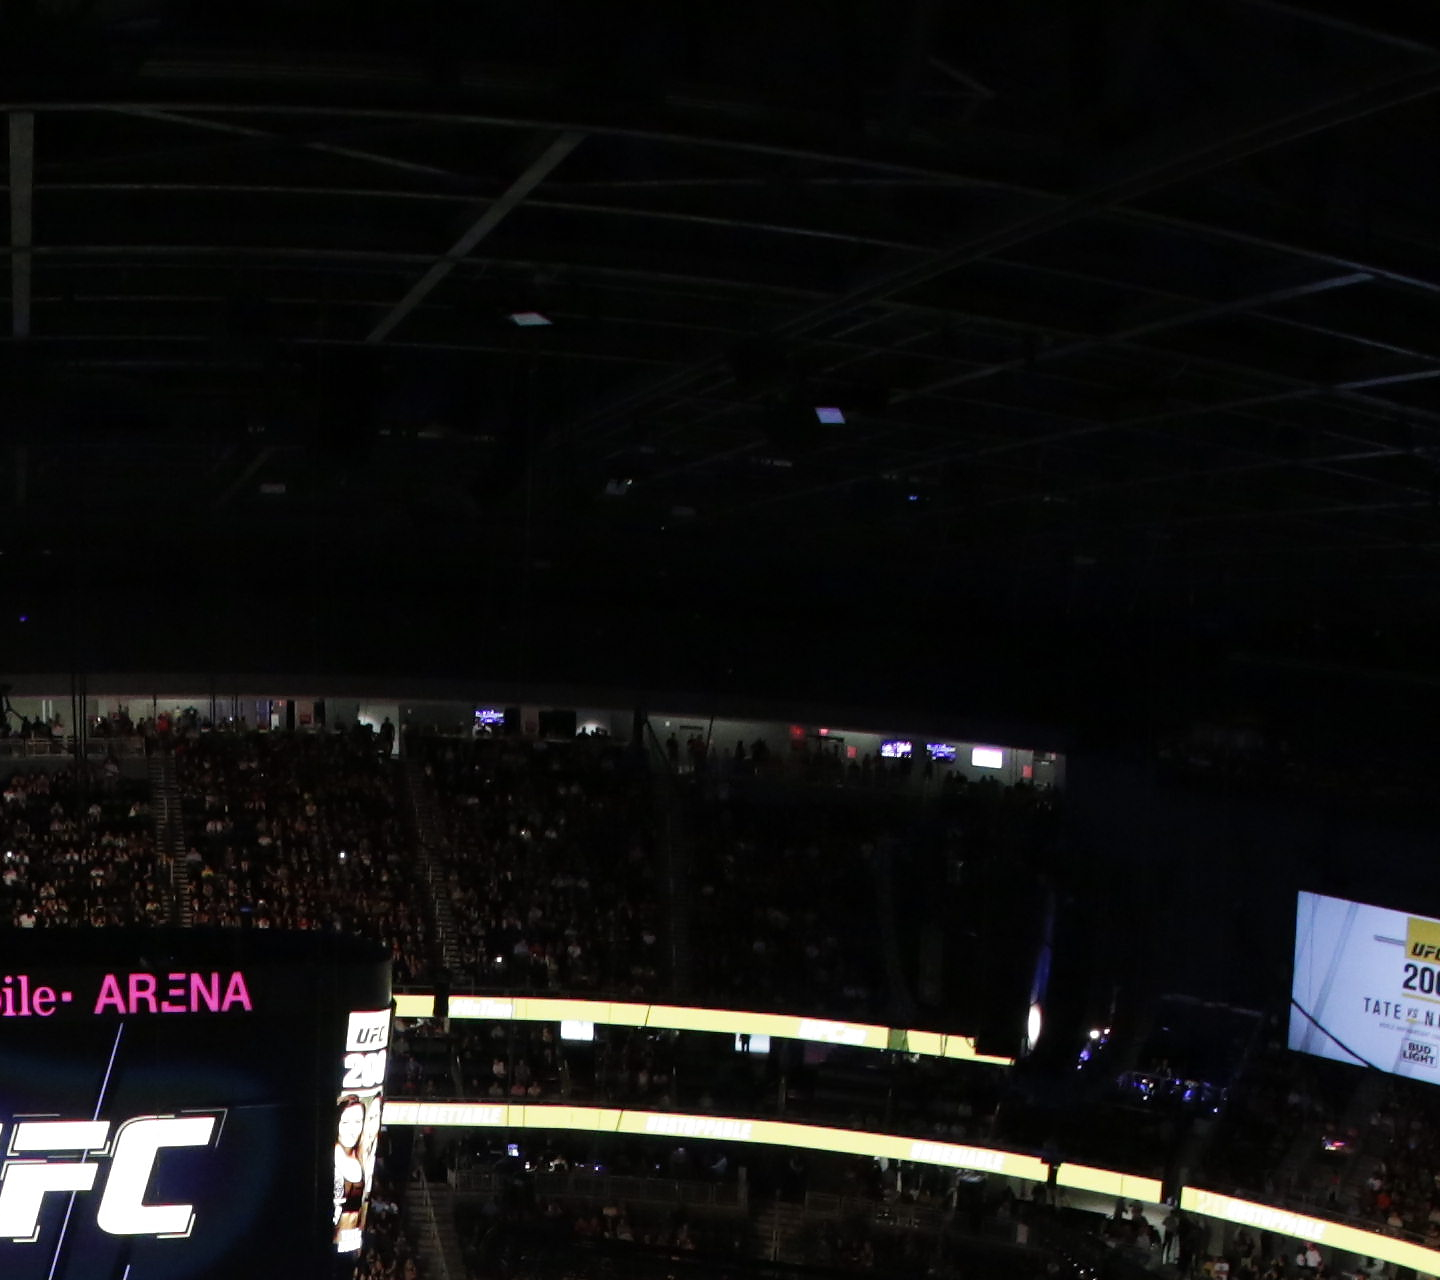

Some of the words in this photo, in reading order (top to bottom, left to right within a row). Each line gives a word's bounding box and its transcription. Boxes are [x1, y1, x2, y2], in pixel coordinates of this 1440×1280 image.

[94, 971, 253, 1016] ARENA
[1363, 997, 1402, 1020] TATE
[356, 1024, 385, 1045] UFC
[1402, 1051, 1436, 1066] LIGHT
[1407, 1041, 1431, 1056] BUD
